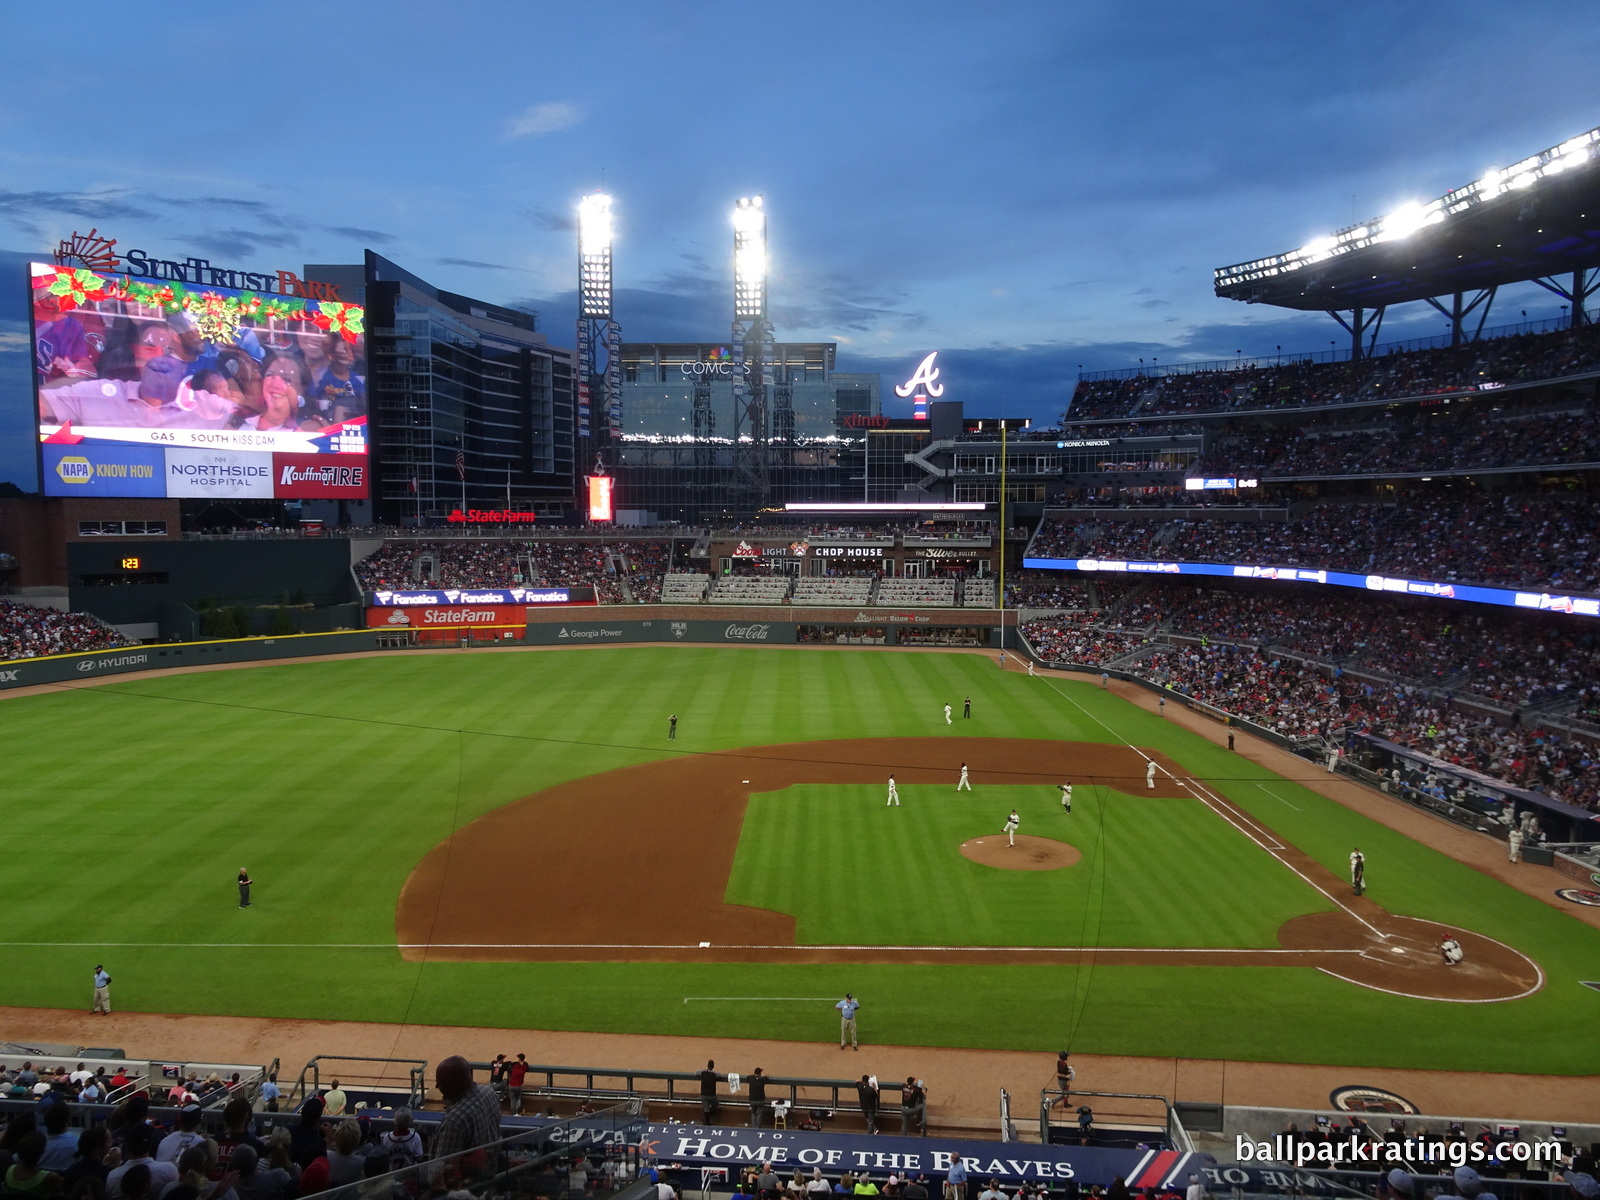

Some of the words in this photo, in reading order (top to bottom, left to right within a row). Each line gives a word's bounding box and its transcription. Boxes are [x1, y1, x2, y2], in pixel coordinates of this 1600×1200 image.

[843, 413, 890, 429] xfinity
[150, 432, 175, 441] GAS
[191, 433, 229, 443] SOUTH
[232, 435, 253, 445] KISS
[255, 435, 275, 446] CAM
[62, 463, 89, 477] NAPA
[96, 464, 129, 478] KNOW
[130, 464, 153, 478] HOW
[171, 464, 269, 477] NORTHSIDE
[190, 478, 252, 486] HOSPITAL
[762, 548, 787, 556] LIGHT
[815, 548, 844, 556] CHOP
[847, 548, 883, 556] HOUSE
[393, 593, 438, 605] Fanatics
[460, 593, 504, 604] Fanatics
[526, 591, 568, 602] Fanatics
[570, 629, 599, 639] Georgia
[600, 629, 623, 637] Power
[98, 654, 148, 669] HYUNDAI
[672, 1136, 788, 1163] HOME
[797, 1148, 843, 1165] OF
[851, 1150, 921, 1170] THE
[930, 1150, 1075, 1178] BRAVES
